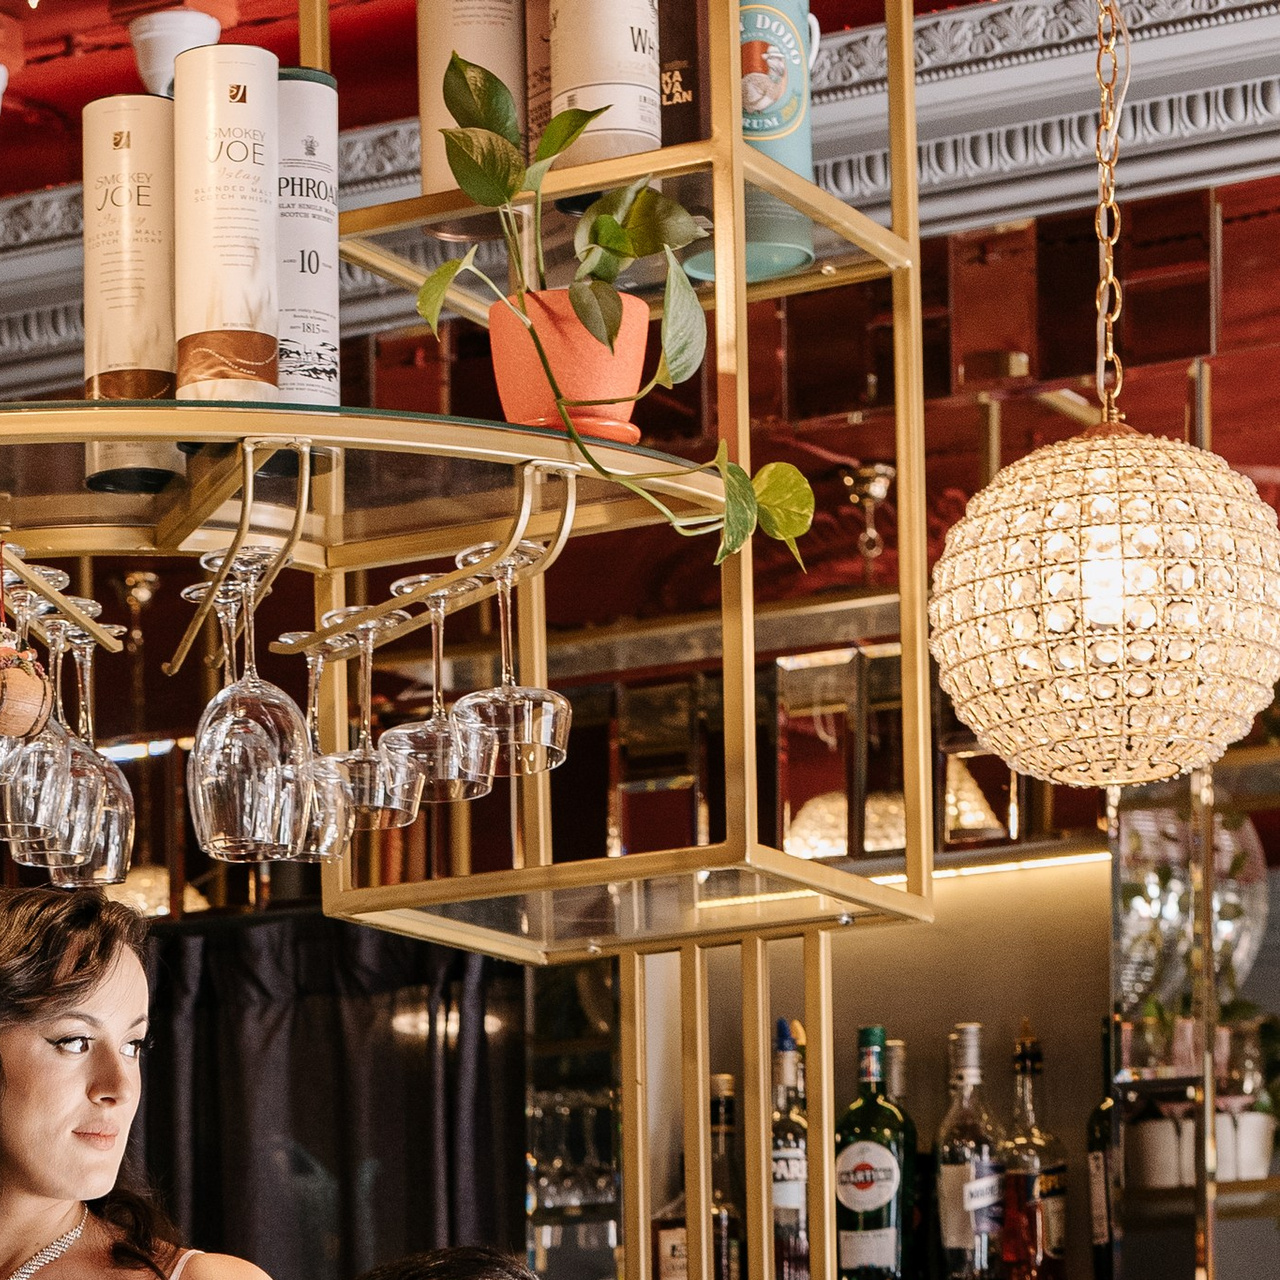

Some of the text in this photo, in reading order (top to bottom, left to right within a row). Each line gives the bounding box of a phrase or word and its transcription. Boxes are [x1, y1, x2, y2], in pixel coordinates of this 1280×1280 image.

[756, 14, 800, 65] DODO
[742, 117, 779, 130] RUM
[207, 127, 266, 142] SMOKEY
[208, 140, 265, 166] JOE
[95, 172, 153, 190] SMOKEY
[218, 167, 261, 184] Islay
[96, 185, 152, 211] JOE
[194, 185, 245, 195] BLENDED
[194, 194, 235, 203] SCOTCH
[278, 177, 338, 206] PHROA
[88, 230, 125, 243] BLENDE
[299, 249, 320, 275] 10
[302, 322, 321, 334] 1815
